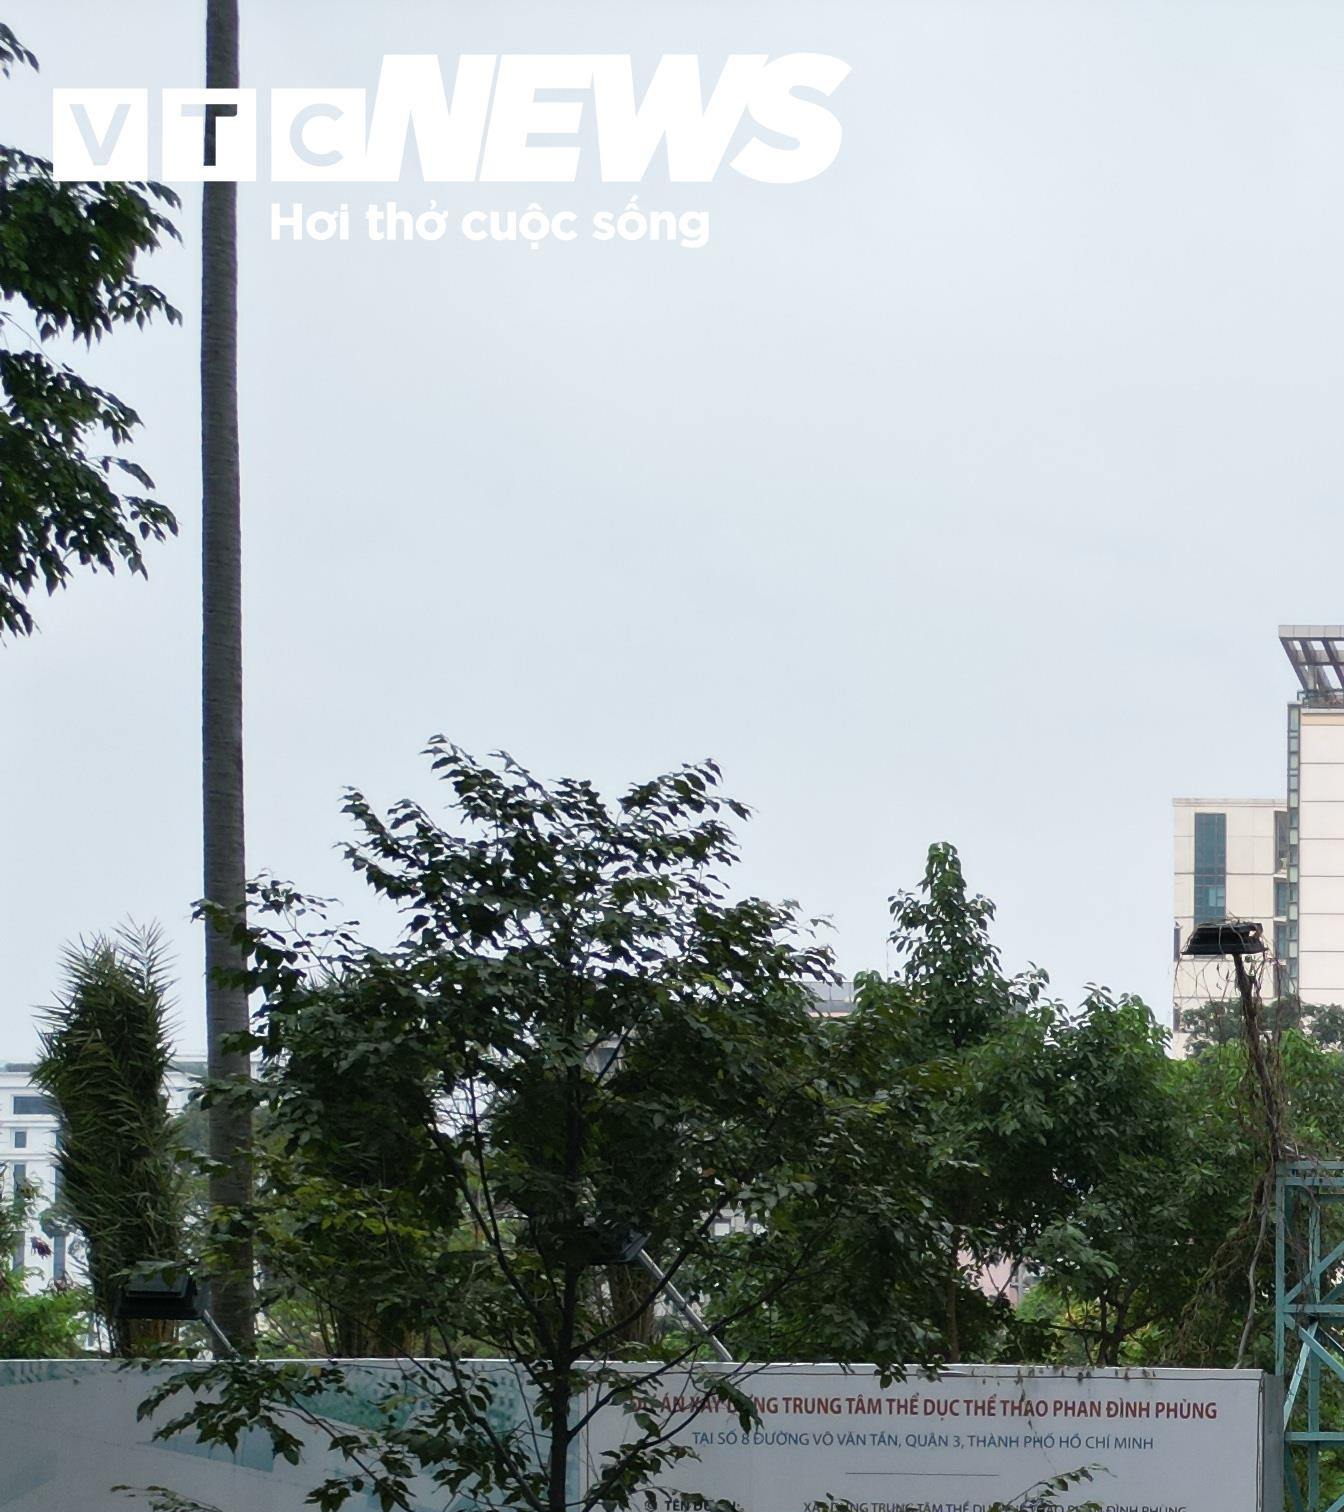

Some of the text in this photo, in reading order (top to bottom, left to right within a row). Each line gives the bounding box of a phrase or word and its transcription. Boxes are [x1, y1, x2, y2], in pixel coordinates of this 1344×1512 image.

[782, 1397, 842, 1414] TRUNG
[847, 1394, 884, 1415] TÂM
[888, 1393, 919, 1416] THỂ
[923, 1400, 959, 1420] DỤC
[963, 1394, 997, 1417] THỂ
[1001, 1400, 1048, 1417] THAO
[1053, 1400, 1101, 1418] PHAN
[1106, 1397, 1150, 1418] ĐÌNH
[1155, 1398, 1217, 1419] PHÙNG
[718, 1429, 738, 1445] SỐ
[741, 1432, 750, 1445] 8
[754, 1430, 810, 1446] ĐƯỜNG
[953, 1435, 965, 1449] 3,
[968, 1432, 1019, 1448] THÀNH
[1024, 1431, 1054, 1449] PHỐ
[1060, 1431, 1081, 1449] HỒ
[1085, 1433, 1110, 1449] CHÍ
[1115, 1437, 1154, 1450] MINH
